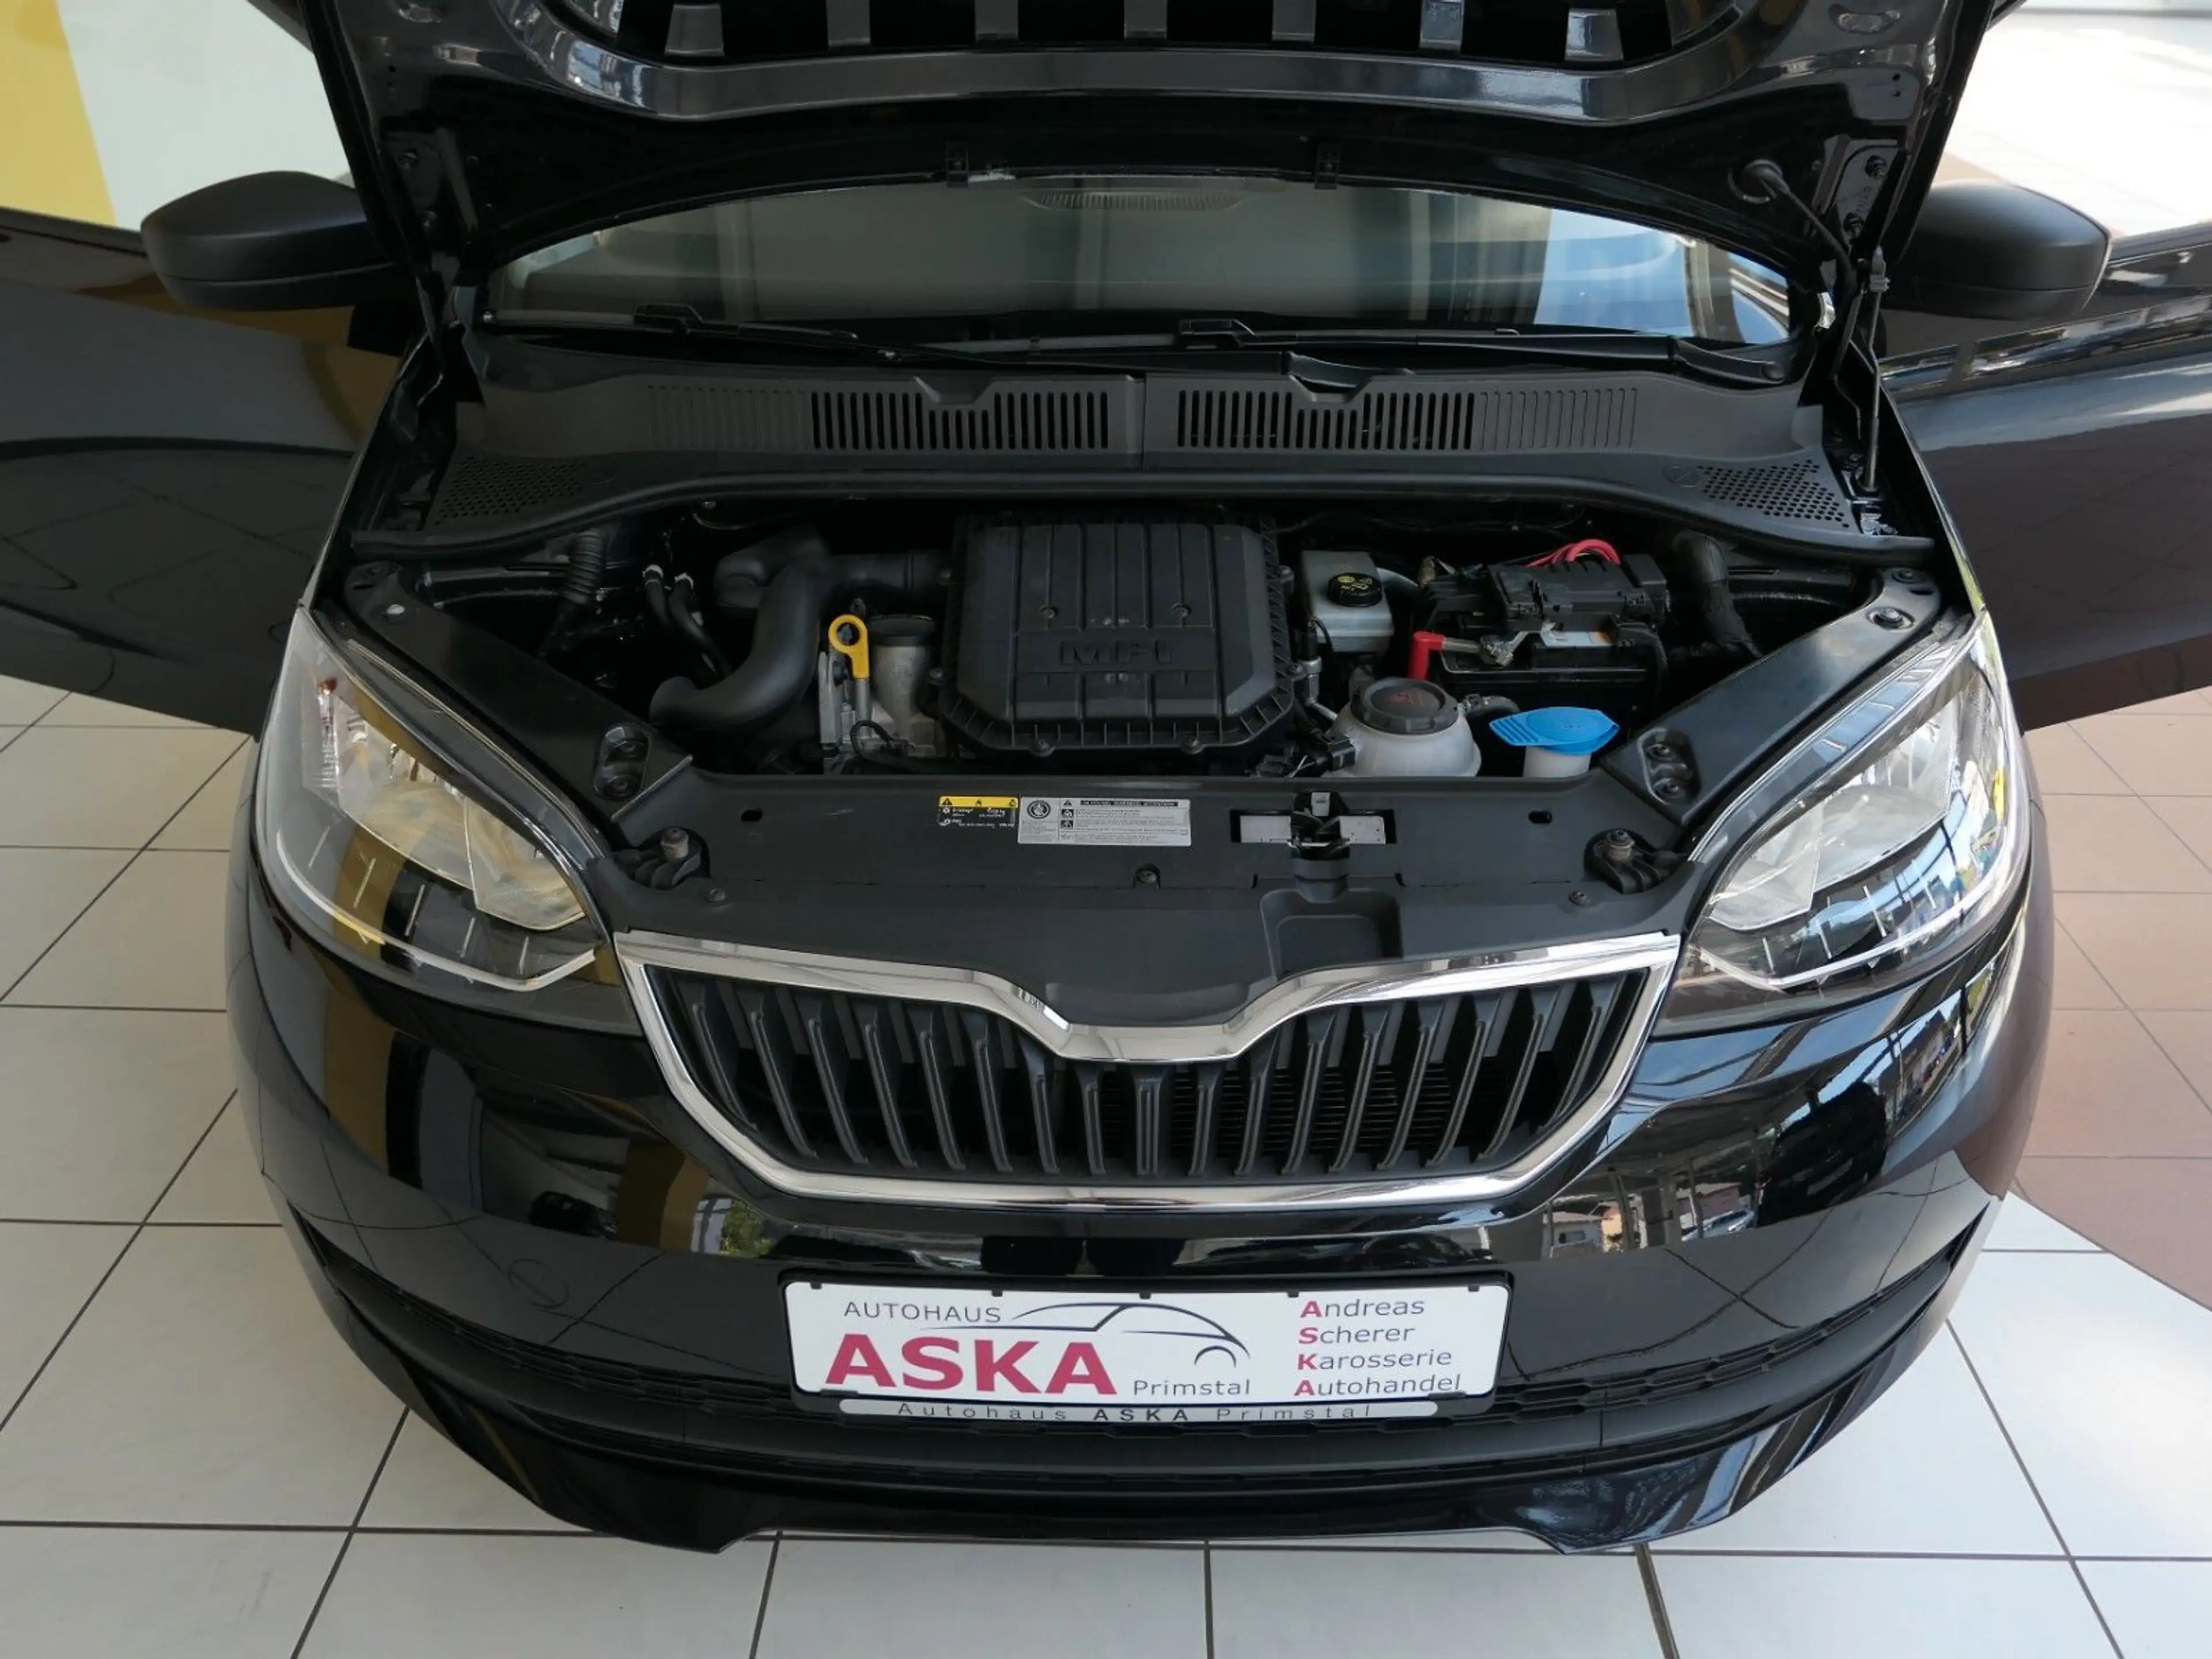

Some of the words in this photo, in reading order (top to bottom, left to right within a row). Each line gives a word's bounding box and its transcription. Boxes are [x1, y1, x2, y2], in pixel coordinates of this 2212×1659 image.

[843, 1301, 1002, 1323] AUTOHAUS
[1300, 1298, 1426, 1318] Andreas
[1298, 1325, 1416, 1344] Scherer
[824, 1333, 1118, 1395] ASKA
[1297, 1349, 1452, 1370] Karosserie
[1134, 1378, 1250, 1396] Primstal
[1294, 1373, 1461, 1396] Autohandel
[897, 1402, 1067, 1422] Autohaus
[1093, 1407, 1190, 1422] ASKA
[1217, 1404, 1371, 1421] Primstal
